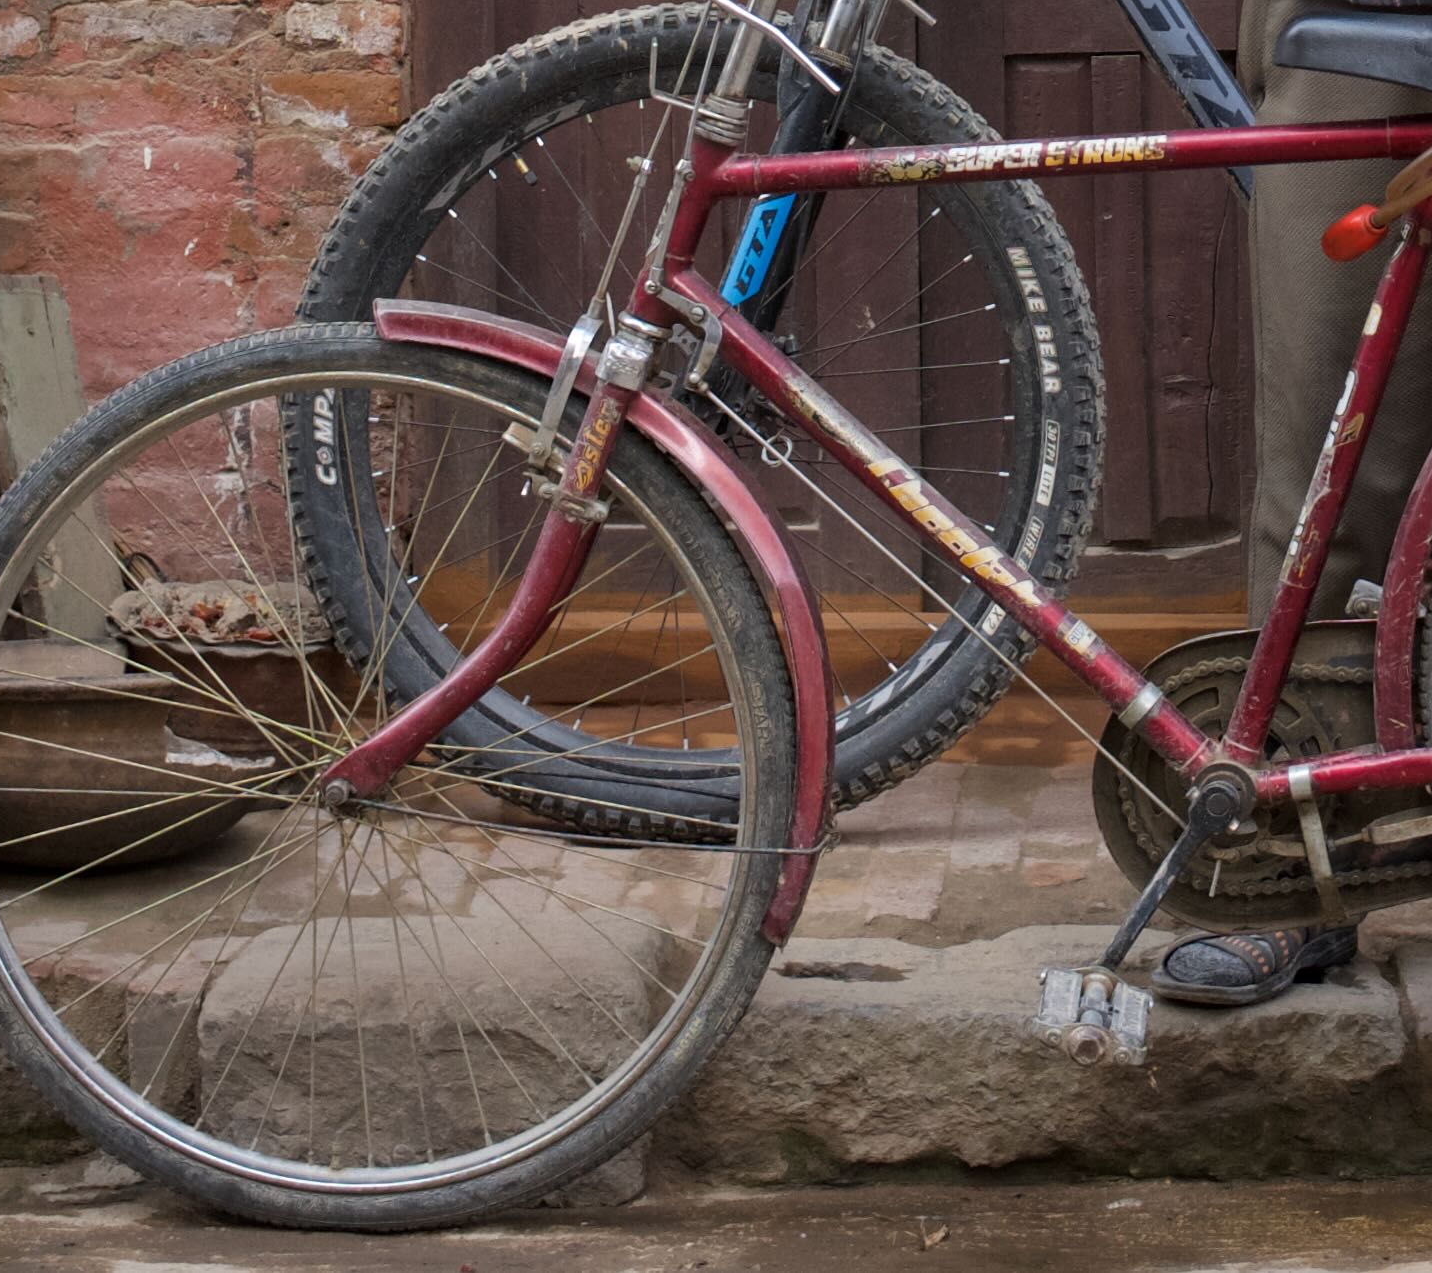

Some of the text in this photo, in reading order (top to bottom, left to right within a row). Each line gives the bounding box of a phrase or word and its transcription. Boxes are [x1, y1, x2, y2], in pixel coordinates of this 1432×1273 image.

[945, 142, 1043, 173] SUPER
[735, 209, 778, 296] GTA
[1006, 246, 1062, 393] MIKE BEAR
